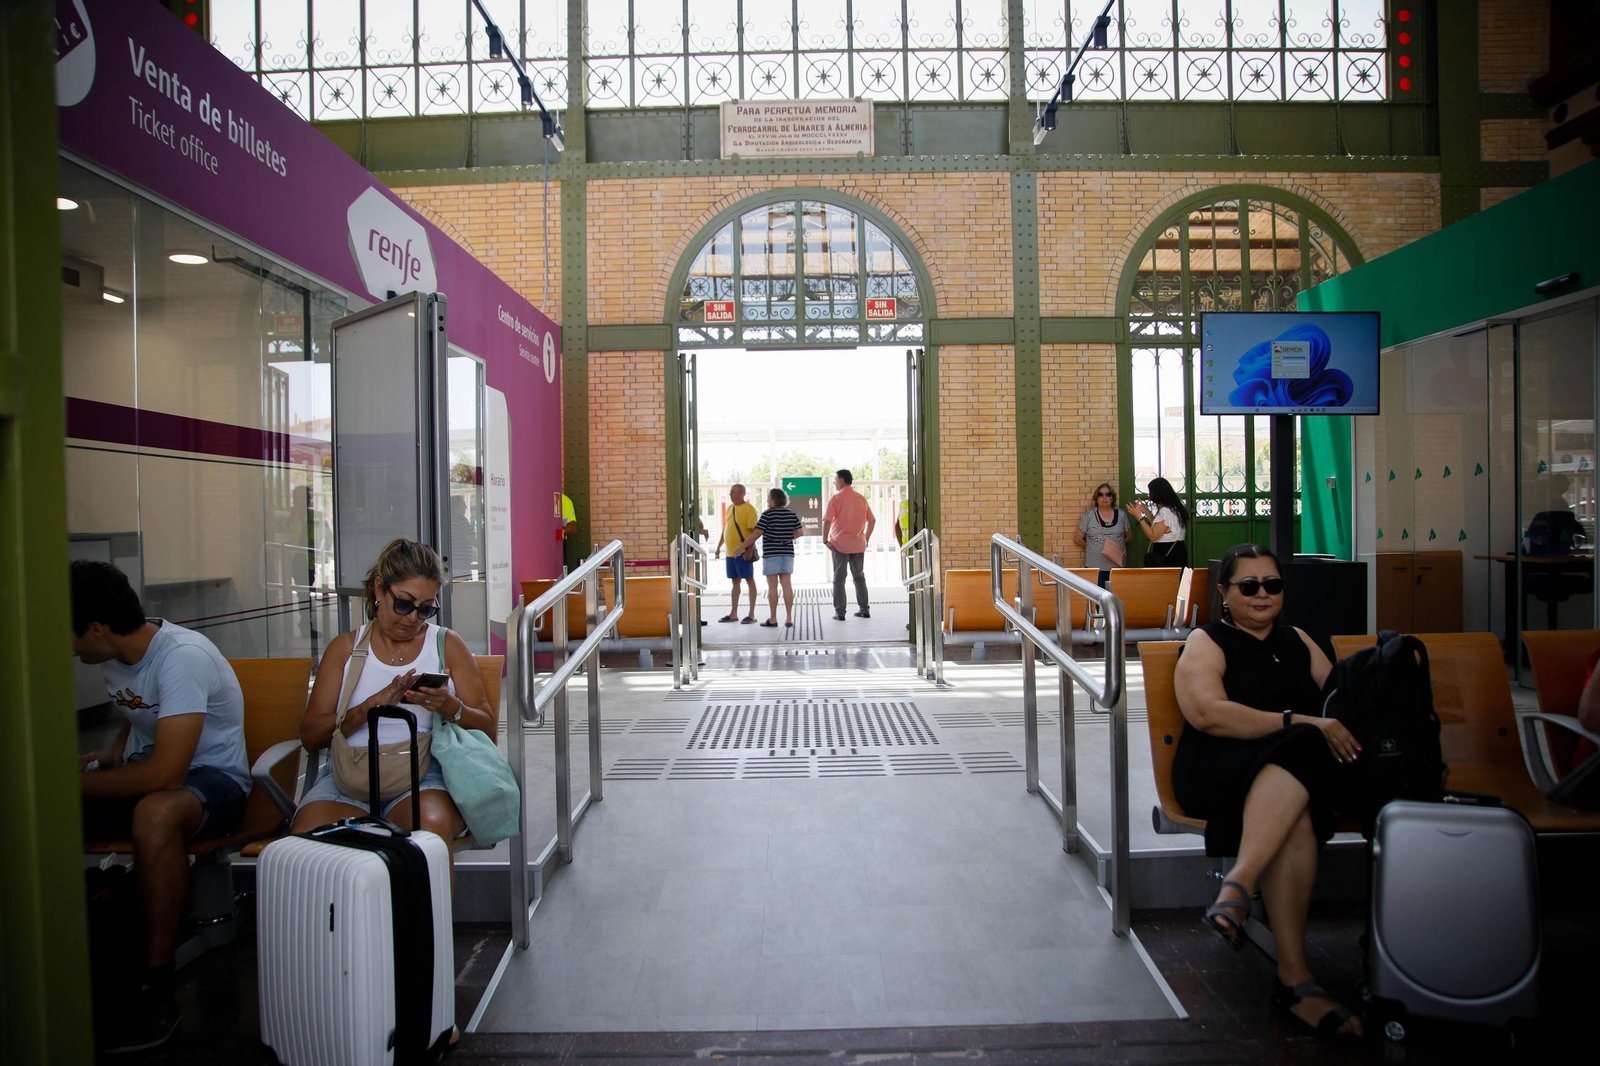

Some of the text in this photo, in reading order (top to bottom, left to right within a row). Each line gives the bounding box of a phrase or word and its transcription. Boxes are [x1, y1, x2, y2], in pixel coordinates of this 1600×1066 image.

[128, 37, 287, 177] Venta de billetes
[736, 105, 857, 115] PARA PERPETUA MEMORIA
[727, 124, 778, 133] FERROCARRIL
[781, 124, 790, 132] DE
[793, 124, 825, 132] LINARES
[129, 96, 218, 175] Ticket office
[368, 228, 421, 285] renfe
[713, 303, 726, 312] SIN
[874, 301, 887, 309] SIN
[707, 311, 733, 320] SALIDA
[868, 308, 894, 317] SALIDA
[498, 304, 540, 347] Centro de servicios
